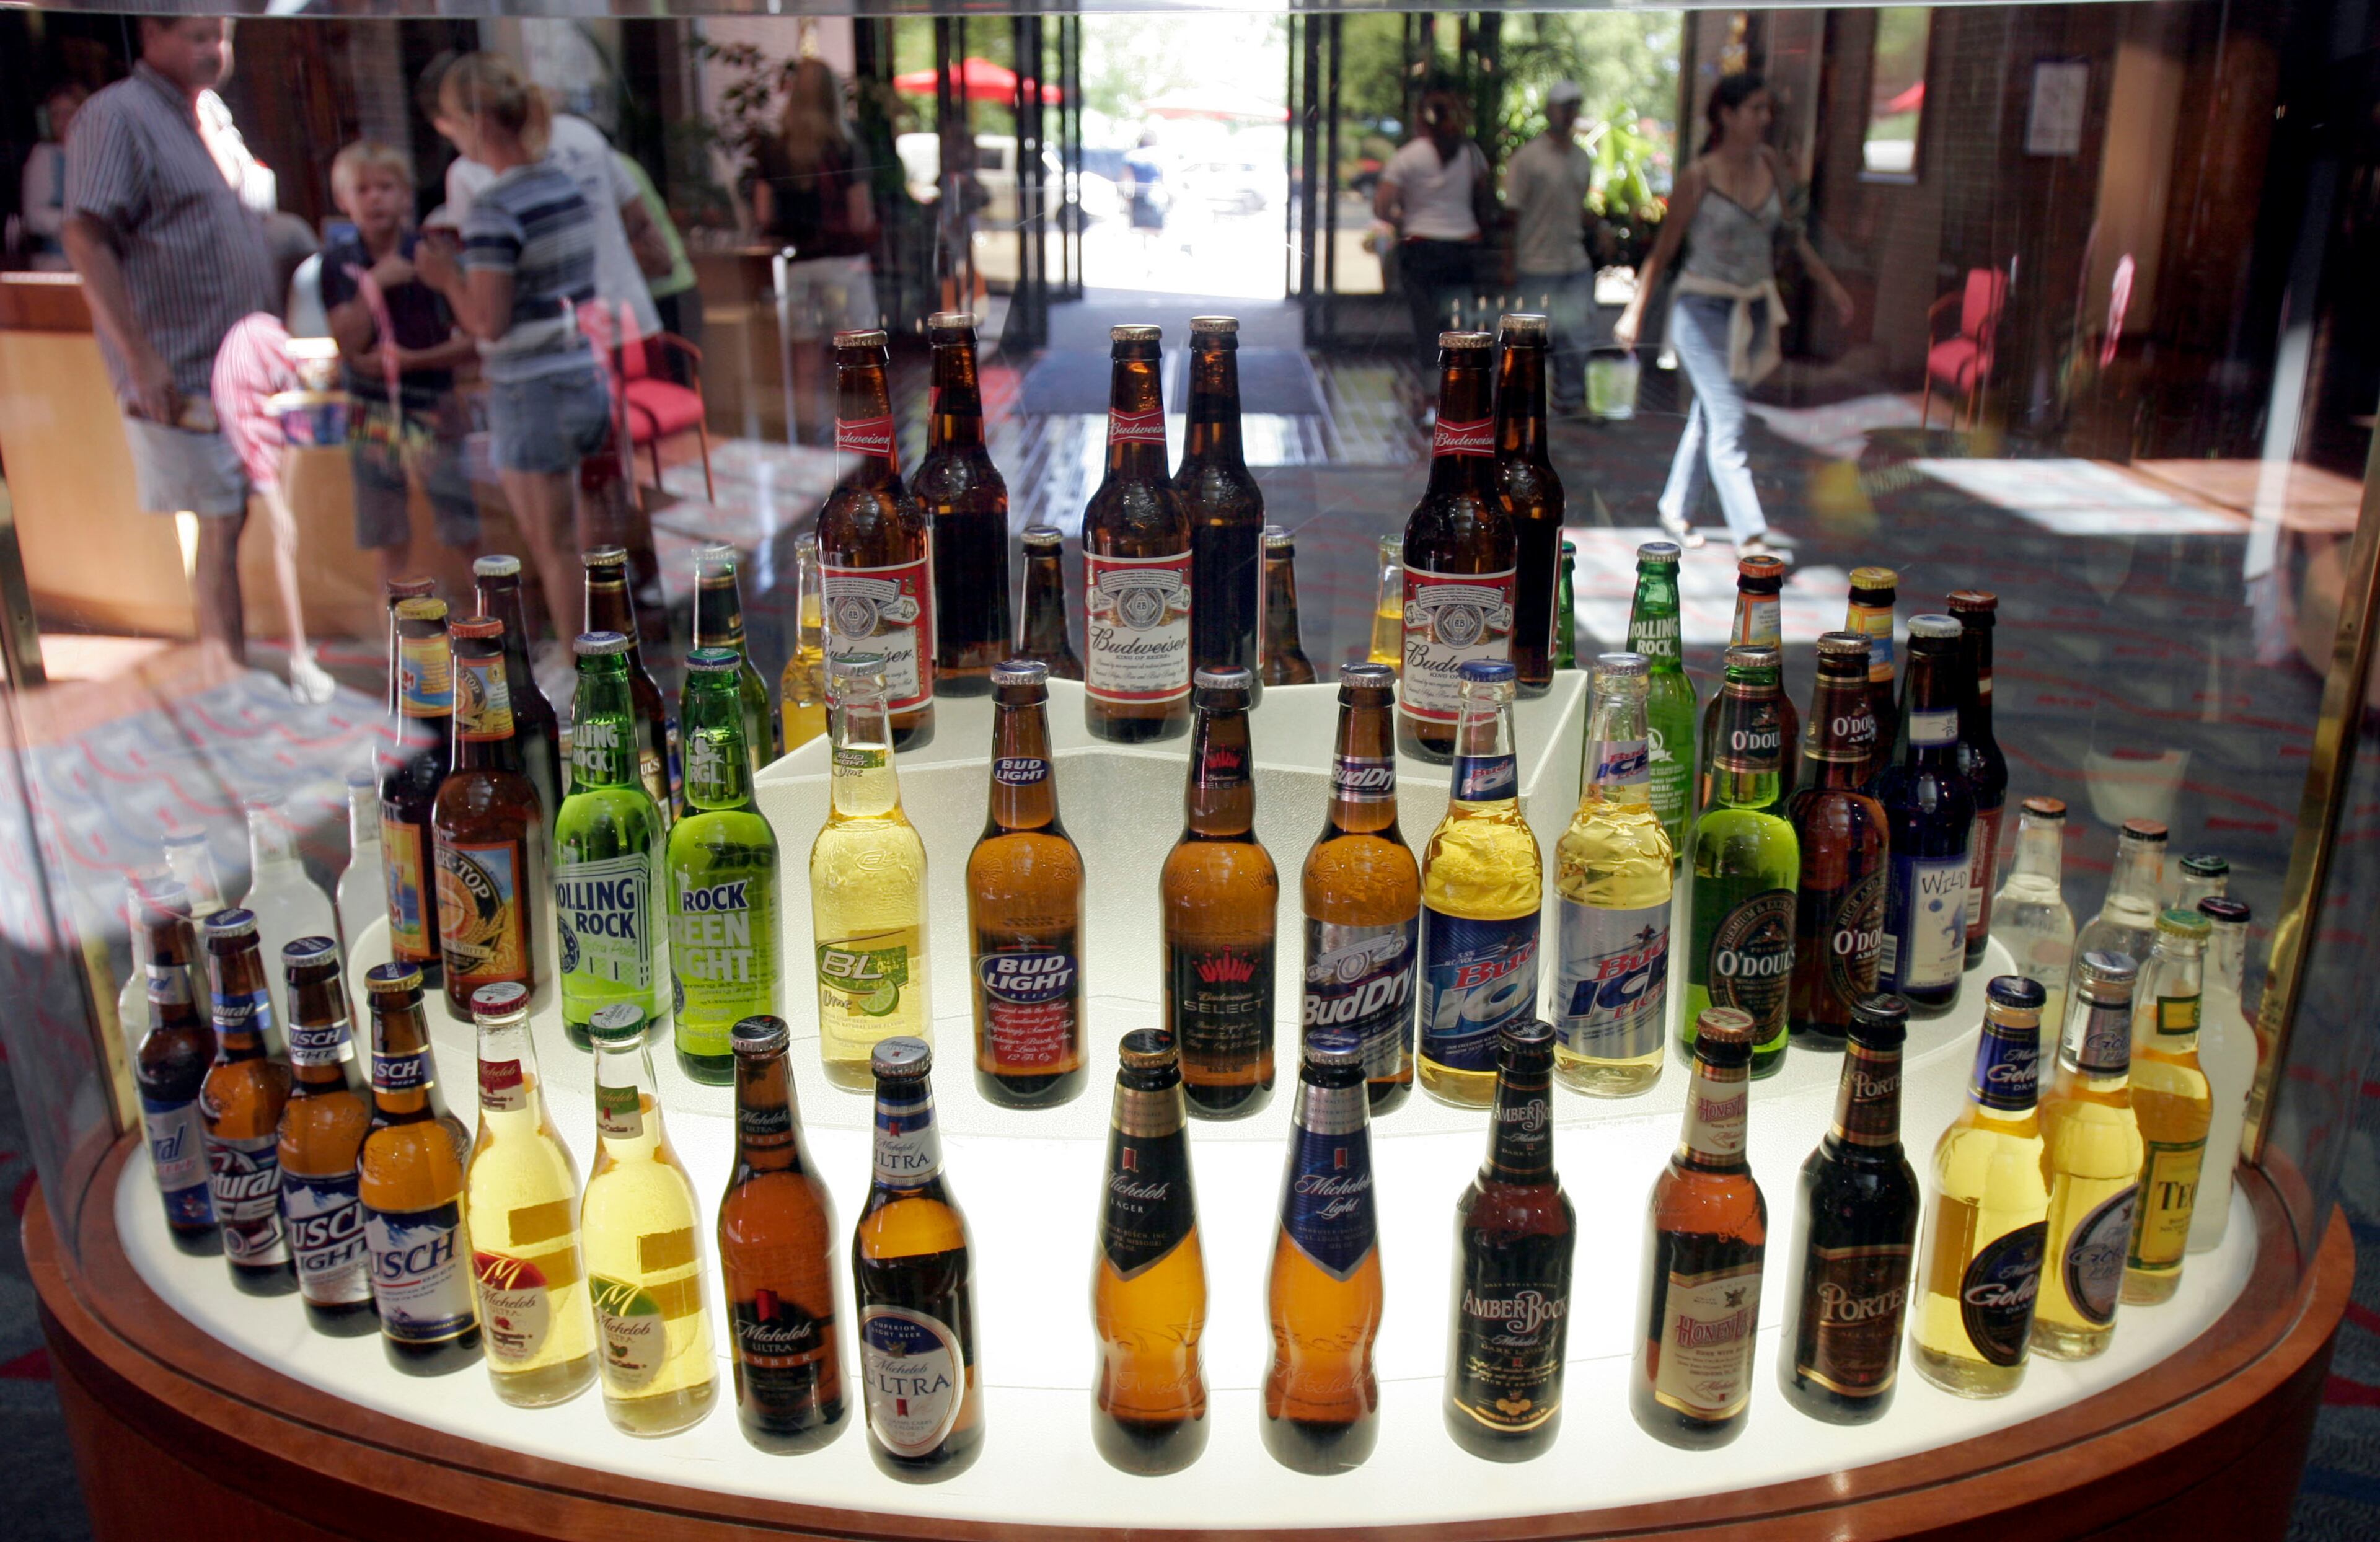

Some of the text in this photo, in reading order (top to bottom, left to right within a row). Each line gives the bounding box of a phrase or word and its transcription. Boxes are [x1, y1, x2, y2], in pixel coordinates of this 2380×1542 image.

[835, 432, 891, 444] udweiser
[1629, 617, 1678, 638] ROLLING
[1090, 626, 1187, 654] Budweiser
[838, 752, 864, 760] BUD
[1001, 760, 1041, 770] BUD
[996, 769, 1045, 780] LIGHT
[457, 860, 490, 899] TOP
[1922, 870, 1967, 894] WILD
[556, 878, 635, 911] OLLING
[682, 881, 749, 912] ROCK
[575, 912, 637, 940] ROCK
[668, 912, 750, 946] REEN
[822, 951, 883, 979] BL
[997, 955, 1065, 974] BUD
[1452, 930, 1540, 990] Bud
[1592, 925, 1670, 982] Bud
[678, 948, 752, 983] IGHT
[987, 968, 1073, 991] LIGHT
[823, 990, 853, 1010] Lime
[1184, 998, 1263, 1014] SELECT
[290, 1029, 340, 1045] USCH
[291, 1048, 333, 1059] IGHT
[211, 1168, 282, 1199] tural
[1295, 1171, 1373, 1196] Michelob
[1111, 1197, 1144, 1213] LAGER
[1315, 1197, 1360, 1220] Light
[299, 1237, 368, 1271] IGHT
[479, 1290, 537, 1308] Michelob
[1817, 1282, 1907, 1321] PORTE
[596, 1315, 652, 1335] Michelob
[734, 1319, 812, 1342] Michelob
[874, 1321, 916, 1331] SUPERIOR
[1676, 1314, 1733, 1349] HONEY
[752, 1342, 793, 1352] ULTRA
[741, 1354, 811, 1367] AMBER
[871, 1356, 928, 1374] Michelob
[864, 1364, 952, 1395] ULTRA
